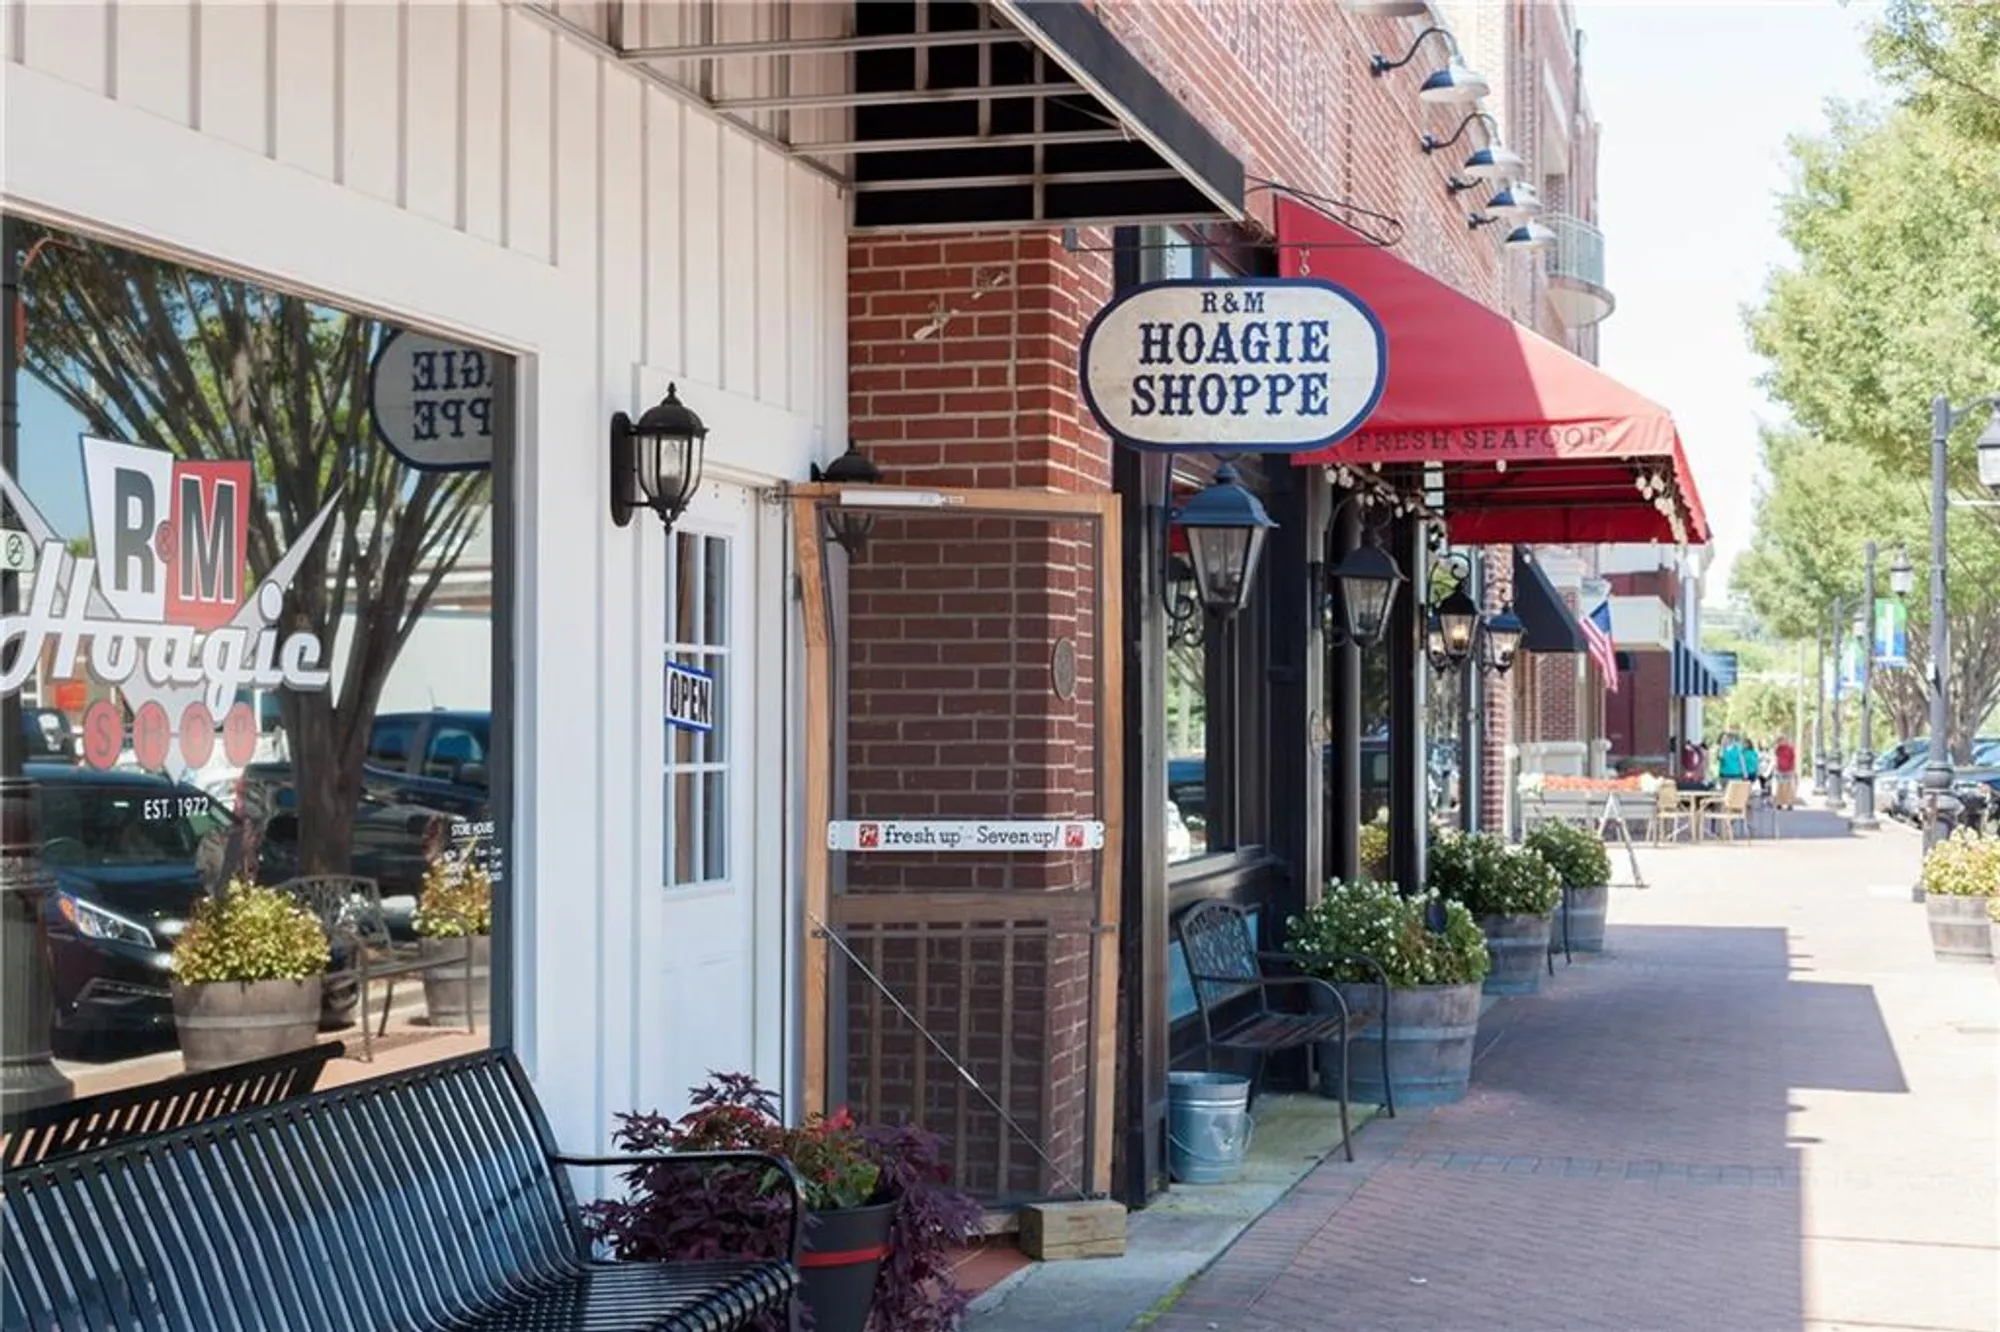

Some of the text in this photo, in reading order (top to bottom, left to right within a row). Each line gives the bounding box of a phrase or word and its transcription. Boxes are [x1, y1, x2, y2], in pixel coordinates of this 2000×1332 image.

[1201, 291, 1265, 314] R&M
[1138, 320, 1331, 366] HOAGIE
[1131, 372, 1329, 417] SHOPPE
[1356, 425, 1607, 452] FRESH SEAFOOD
[0, 540, 330, 725] Hoagie
[670, 671, 709, 723] OPEN
[96, 709, 247, 758] SHOP
[144, 796, 209, 820] EST. 1972
